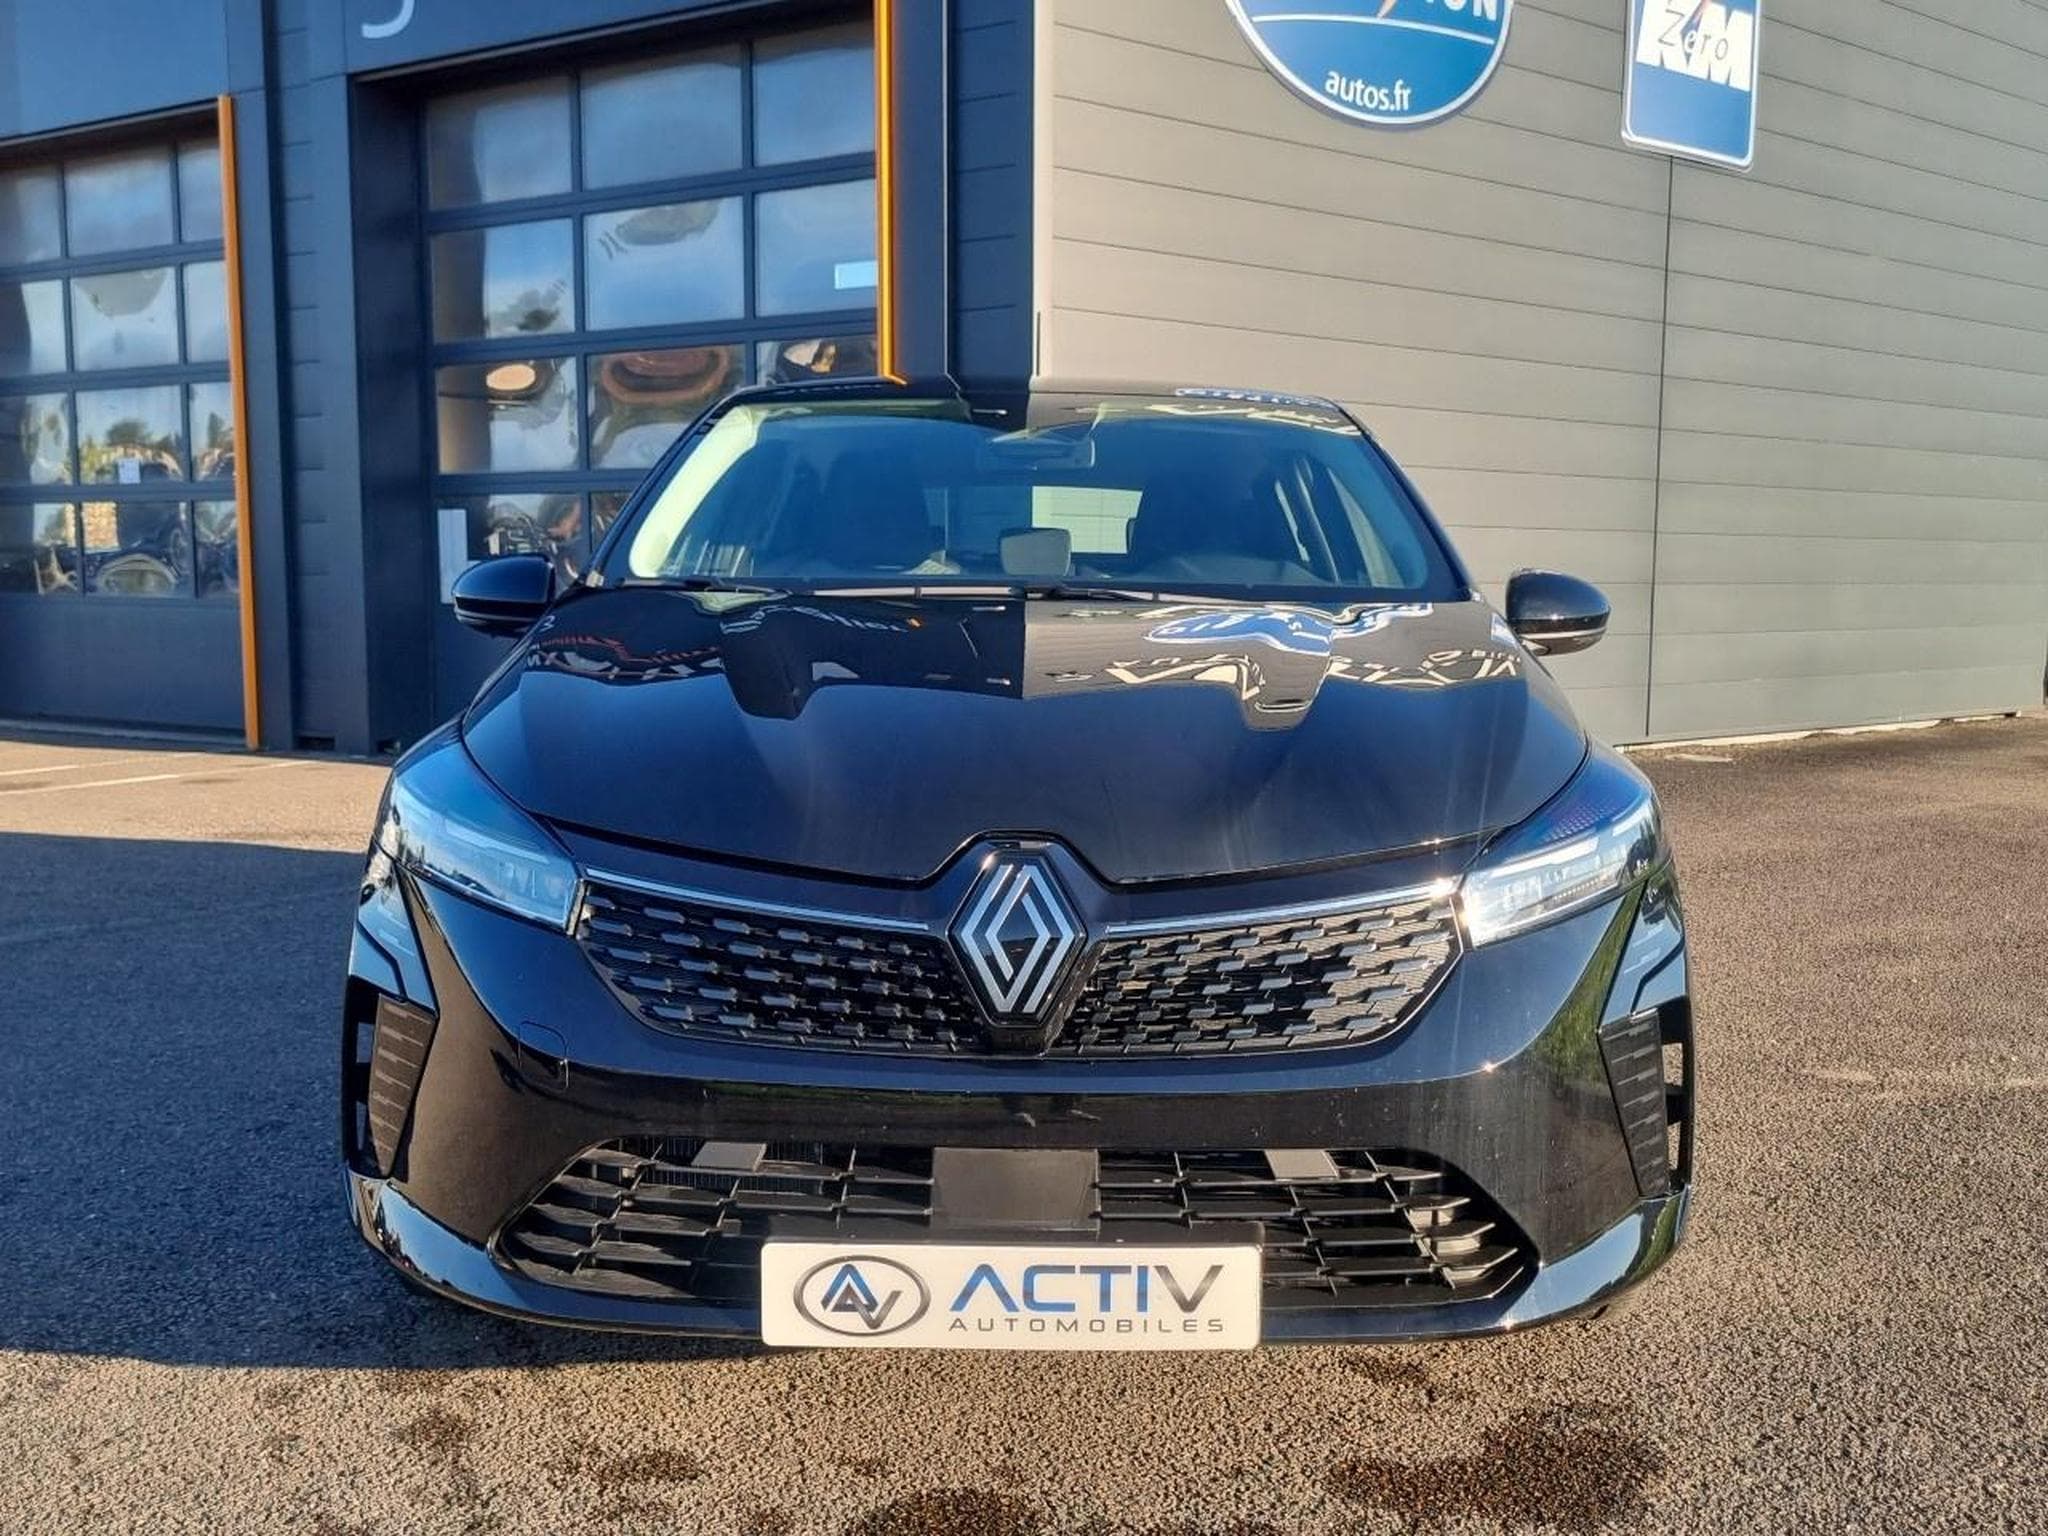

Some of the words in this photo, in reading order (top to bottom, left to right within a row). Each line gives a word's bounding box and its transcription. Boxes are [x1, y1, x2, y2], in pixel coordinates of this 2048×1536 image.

[1325, 71, 1412, 111] autos.fr
[949, 1263, 1224, 1313] ACTIV
[948, 1317, 1224, 1333] AUTOMOBILES
